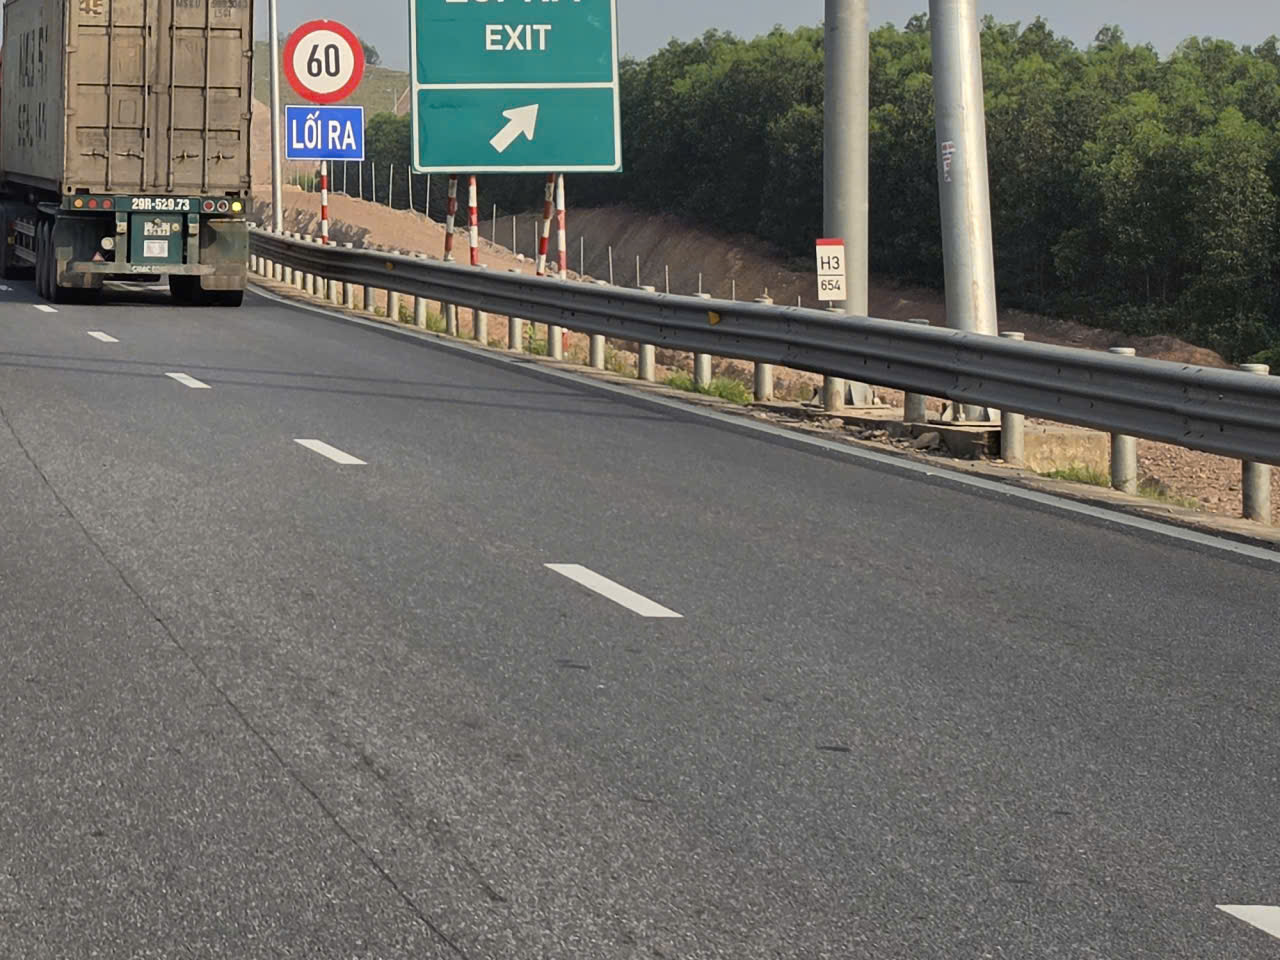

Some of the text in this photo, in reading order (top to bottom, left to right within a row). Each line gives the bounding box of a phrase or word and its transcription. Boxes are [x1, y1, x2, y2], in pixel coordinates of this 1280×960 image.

[485, 24, 552, 51] EXIT
[306, 44, 340, 78] 60
[292, 111, 356, 150] LỐI RA
[820, 256, 840, 270] H3
[821, 280, 840, 291] 654
